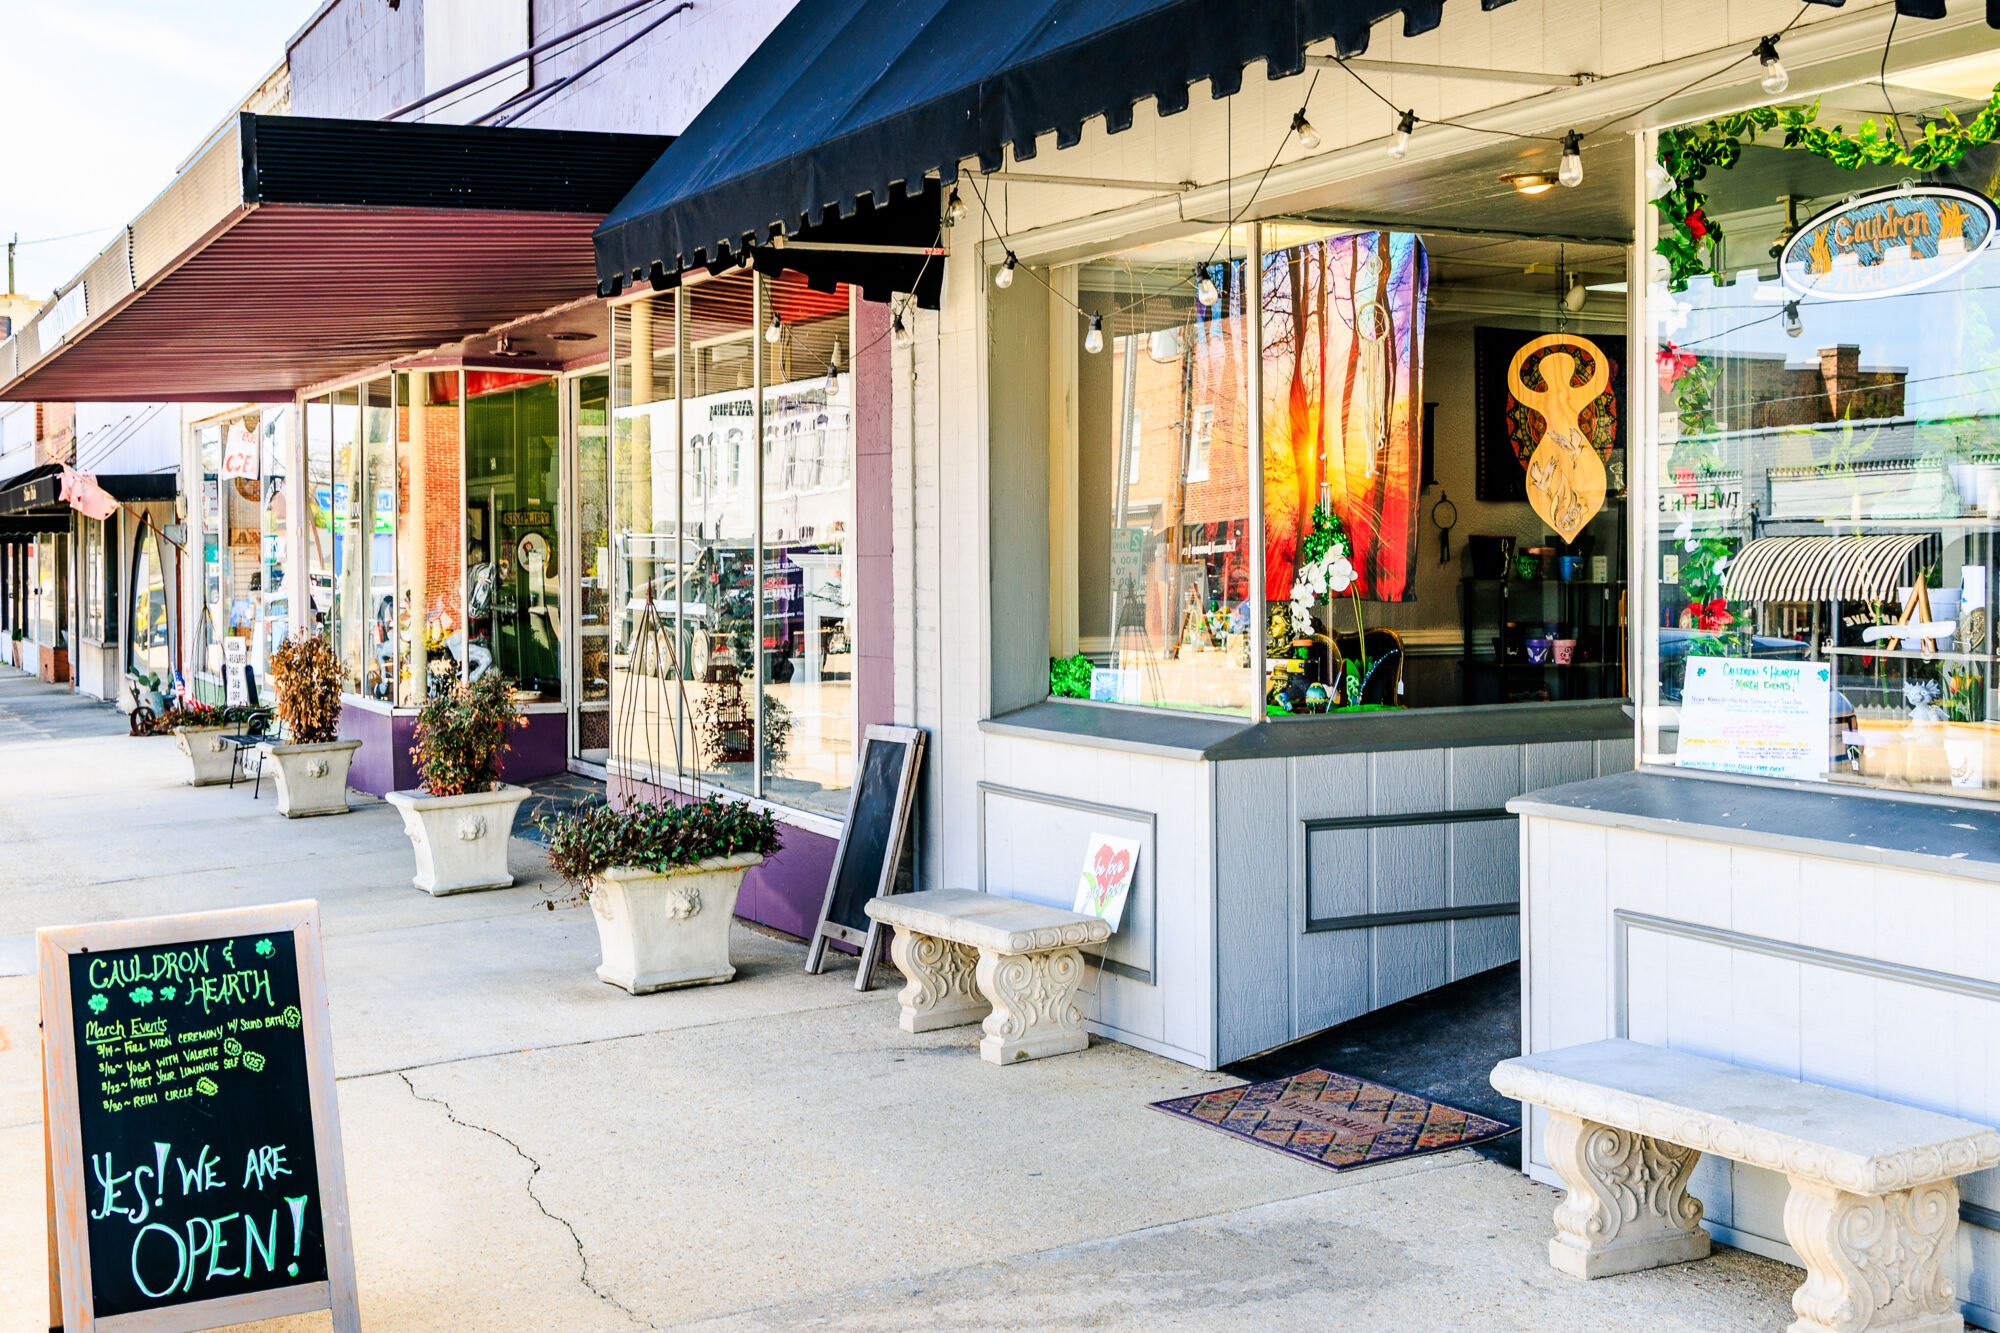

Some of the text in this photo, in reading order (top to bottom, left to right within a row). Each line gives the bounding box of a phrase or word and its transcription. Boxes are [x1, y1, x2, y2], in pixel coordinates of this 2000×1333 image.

[1834, 205, 1929, 248] Cauldron
[89, 940, 236, 989] CAULDRON &
[184, 970, 275, 1015] HEARTH
[85, 1017, 168, 1039] March Events
[124, 1041, 148, 1055] FULL
[156, 1054, 180, 1068] WITH
[183, 1046, 219, 1062] VALERIE
[130, 1076, 153, 1090] MEET
[180, 1061, 220, 1079] LUMINOUS
[223, 1056, 240, 1070] SELF
[133, 1093, 158, 1108] REIKI
[164, 1087, 194, 1101] CIRCLE
[91, 1142, 293, 1224] YES! WE ARE
[131, 1194, 308, 1298] OPEN!
